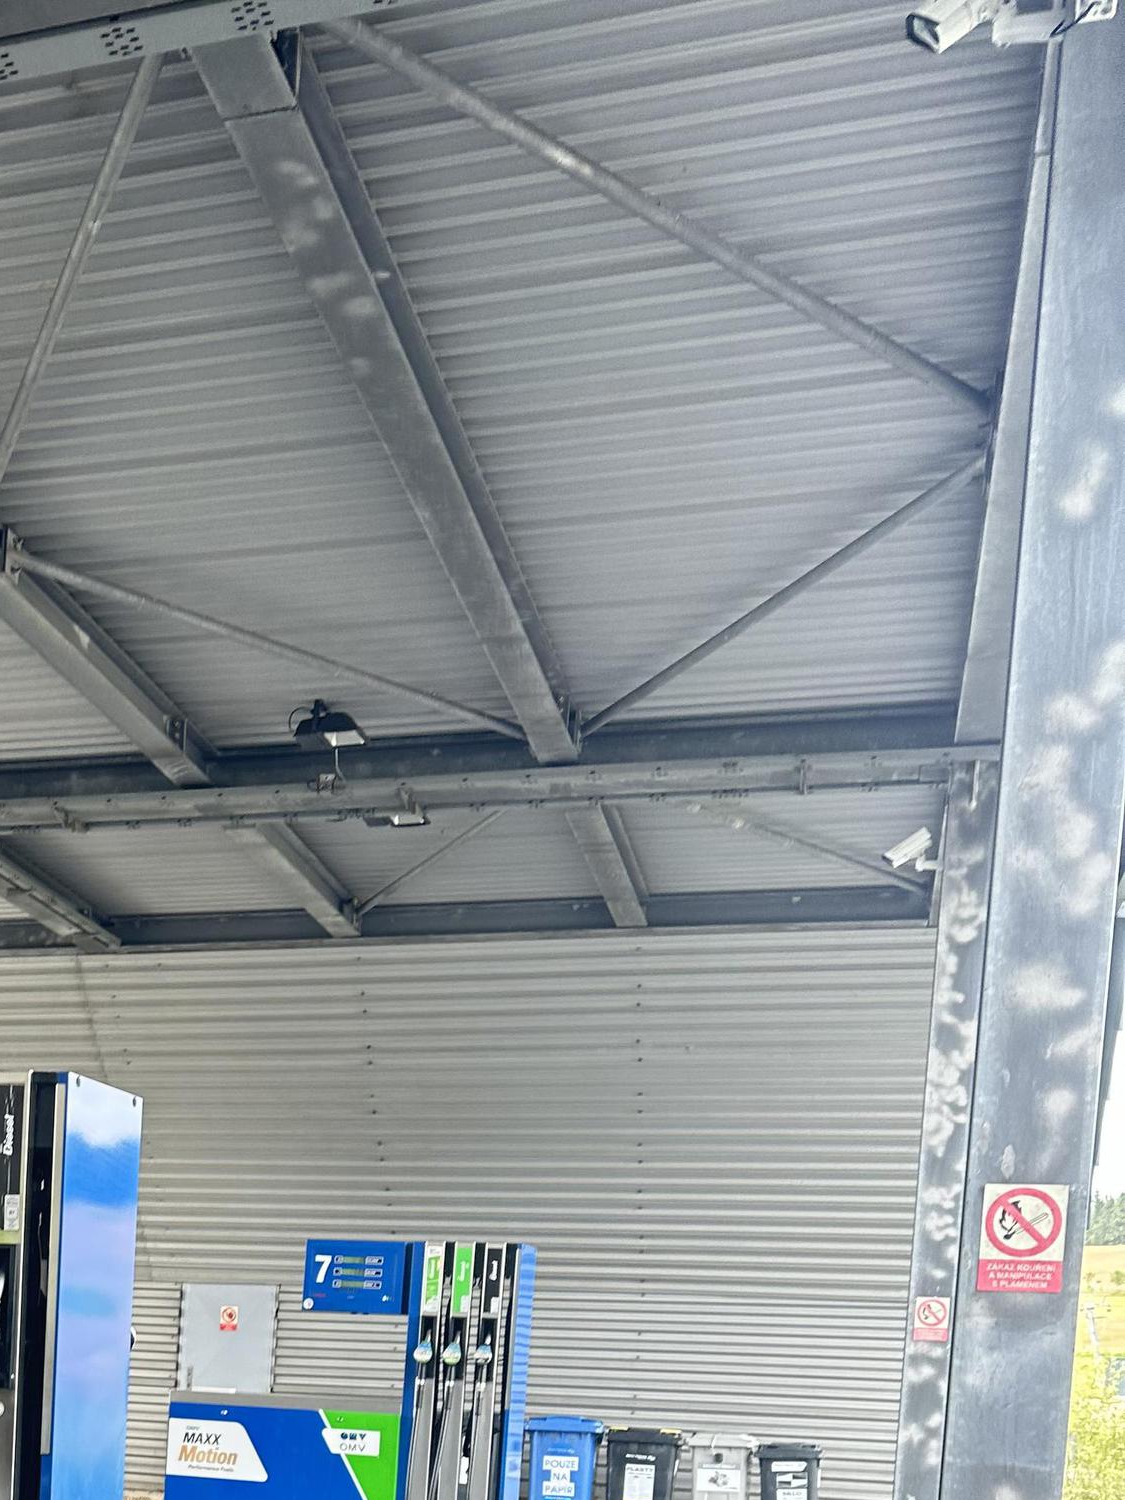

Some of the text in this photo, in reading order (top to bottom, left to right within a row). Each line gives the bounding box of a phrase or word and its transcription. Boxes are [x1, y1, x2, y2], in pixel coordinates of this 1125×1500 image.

[3, 1113, 15, 1156] Diesel
[314, 1254, 332, 1284] 7
[996, 1272, 1052, 1280] MANIPULACE
[182, 1432, 222, 1445] MAXX
[339, 1443, 365, 1452] OMV
[178, 1444, 238, 1466] Motion
[545, 1459, 576, 1469] POUZE
[553, 1472, 568, 1481] NA
